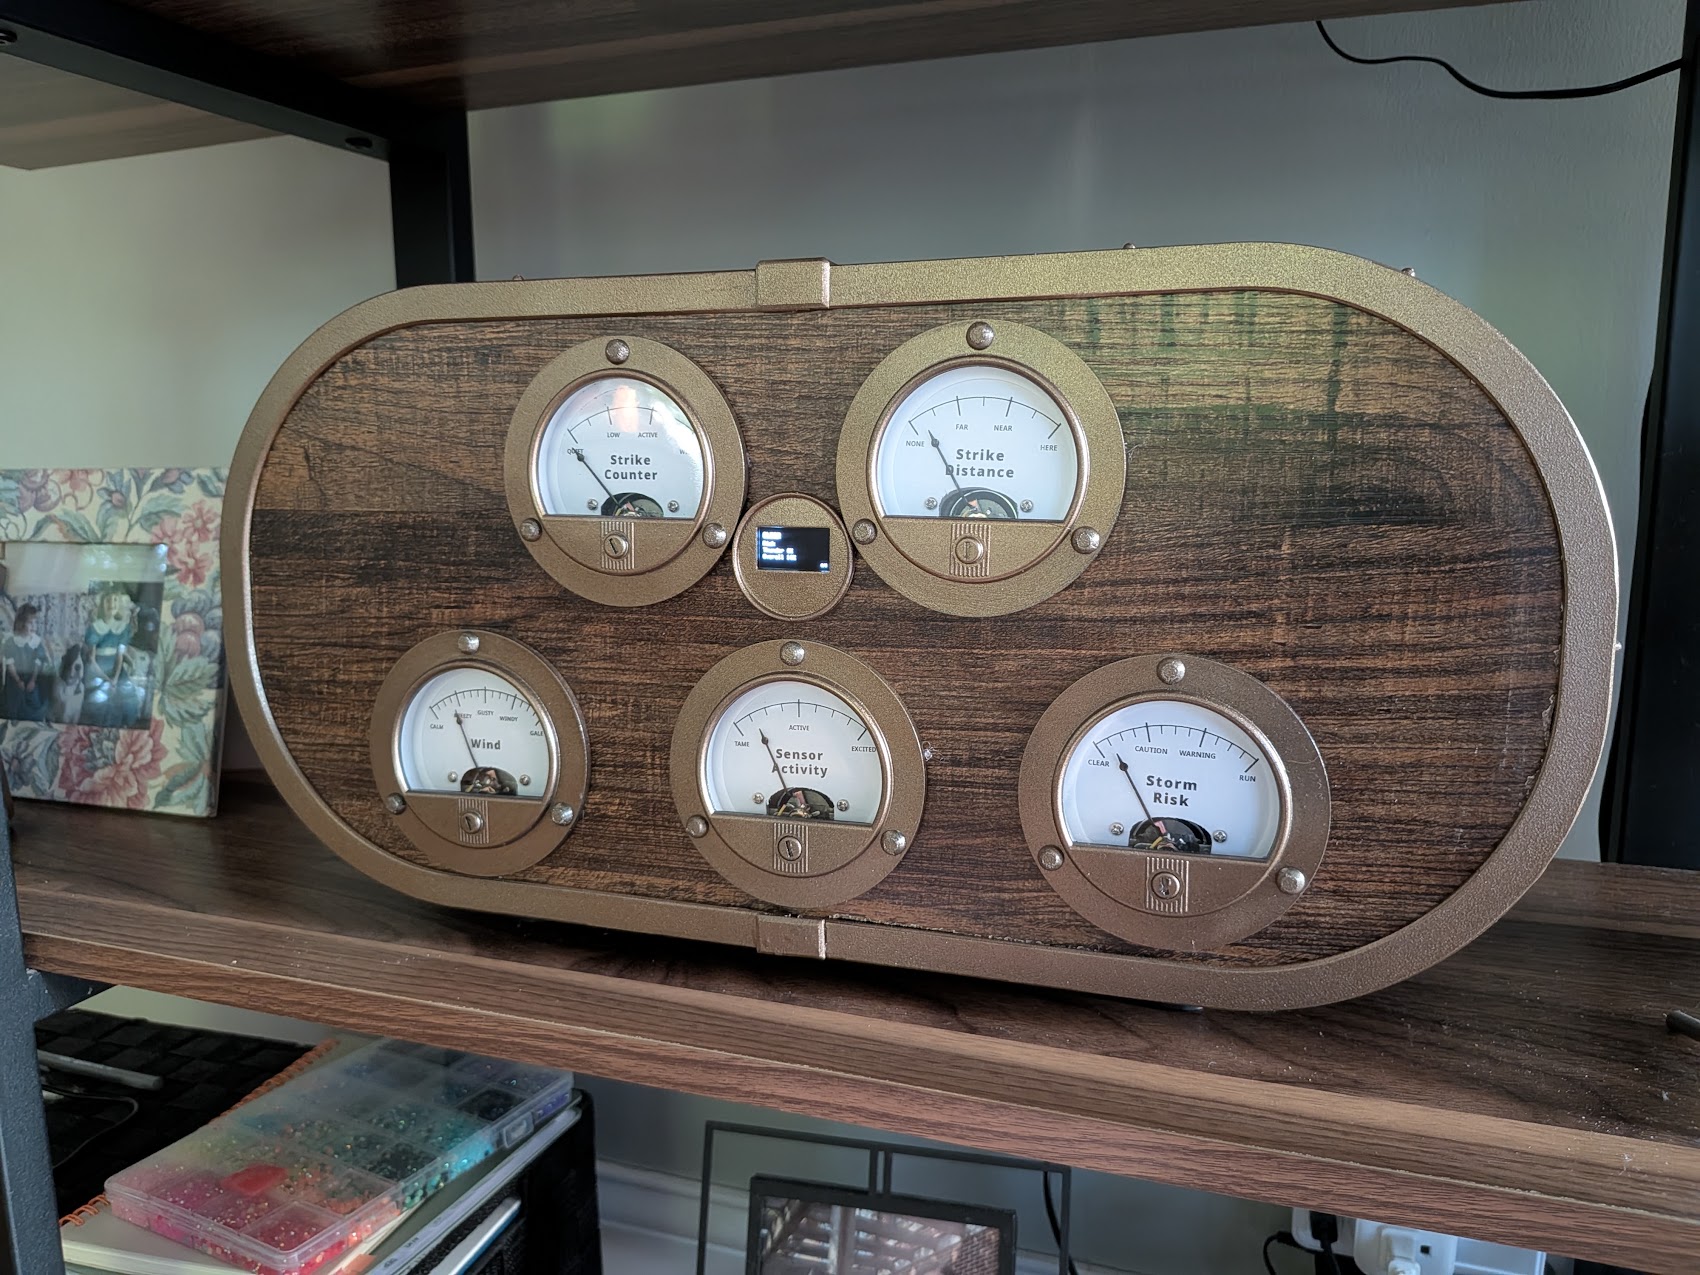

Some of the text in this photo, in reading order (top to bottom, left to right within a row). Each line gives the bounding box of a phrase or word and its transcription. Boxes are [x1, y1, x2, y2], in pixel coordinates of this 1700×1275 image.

[1040, 444, 1058, 452] HERE
[610, 454, 651, 465] Strike
[956, 448, 1005, 461] Strike
[604, 469, 658, 480] Counter
[945, 463, 1014, 478] Distance
[471, 738, 501, 750] Wind
[776, 748, 823, 761] Sensor
[1134, 745, 1168, 755] CAUTION
[1179, 749, 1216, 760] WARNING
[1088, 759, 1110, 767] CLEAR
[771, 763, 828, 778] Activity
[1146, 775, 1197, 791] Storm
[1239, 774, 1257, 783] RUN
[1153, 792, 1189, 807] Risk
